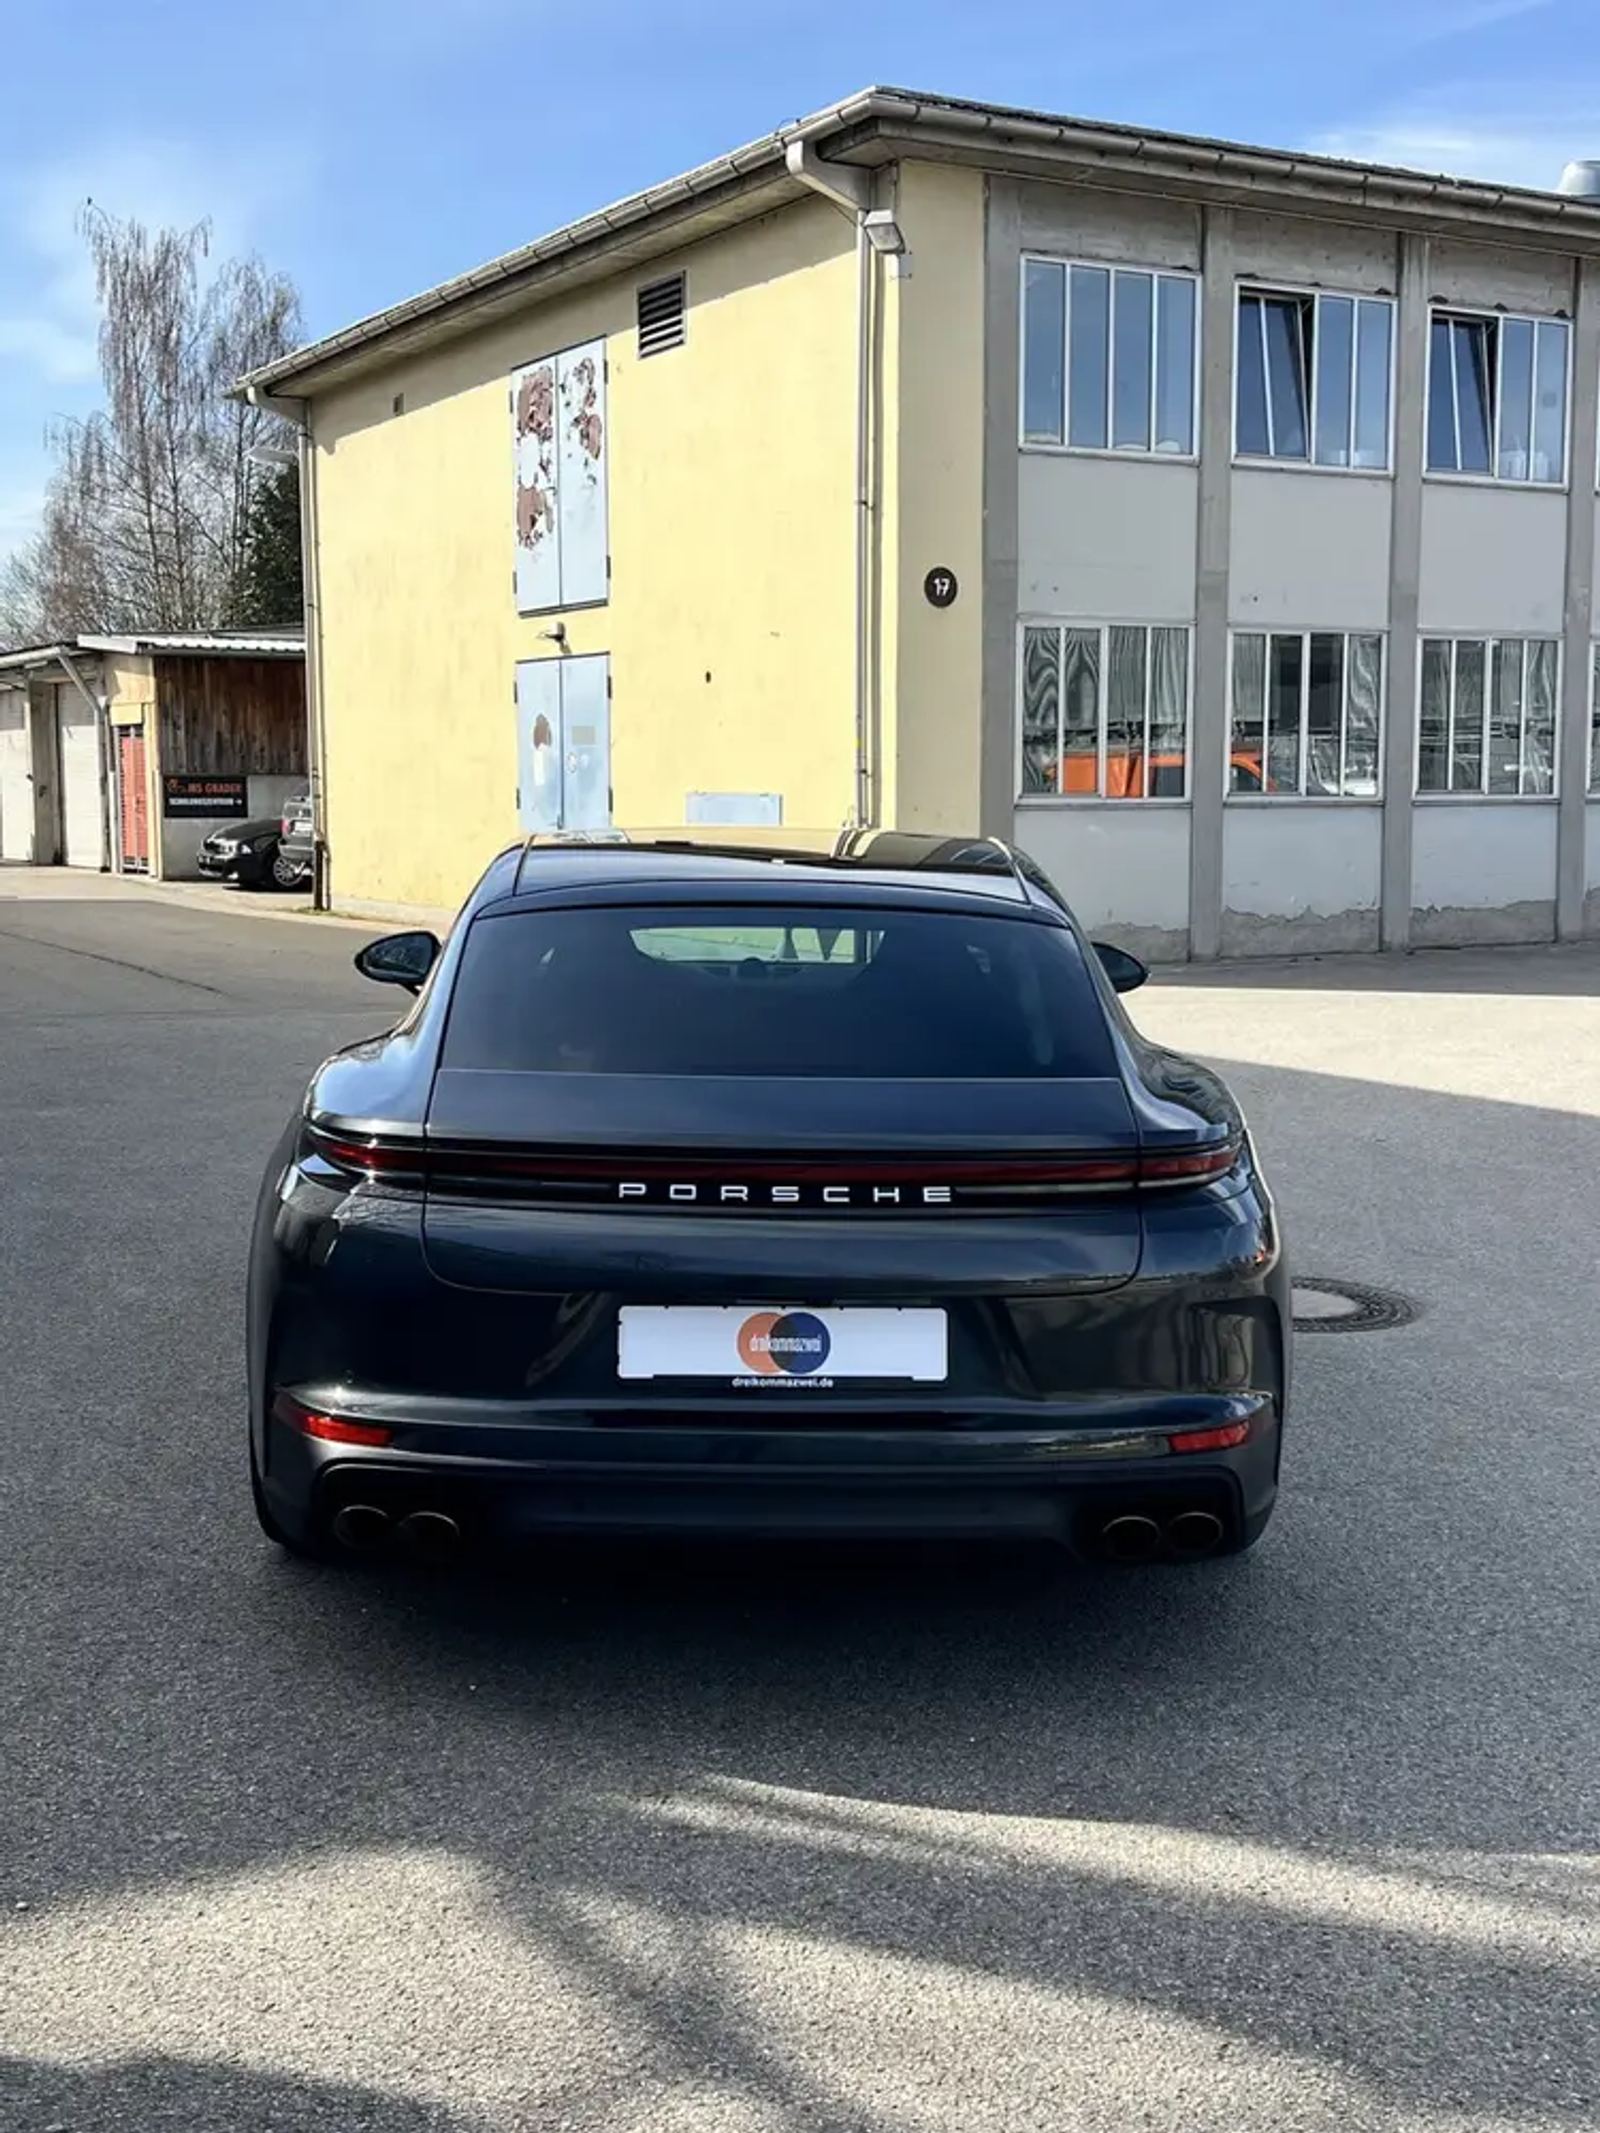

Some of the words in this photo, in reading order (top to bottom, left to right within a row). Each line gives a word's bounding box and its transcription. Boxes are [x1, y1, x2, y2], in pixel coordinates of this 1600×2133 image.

[934, 578, 950, 596] 17
[618, 1183, 951, 1203] PORSCHE
[731, 1377, 834, 1388] dreikommazwei.de
